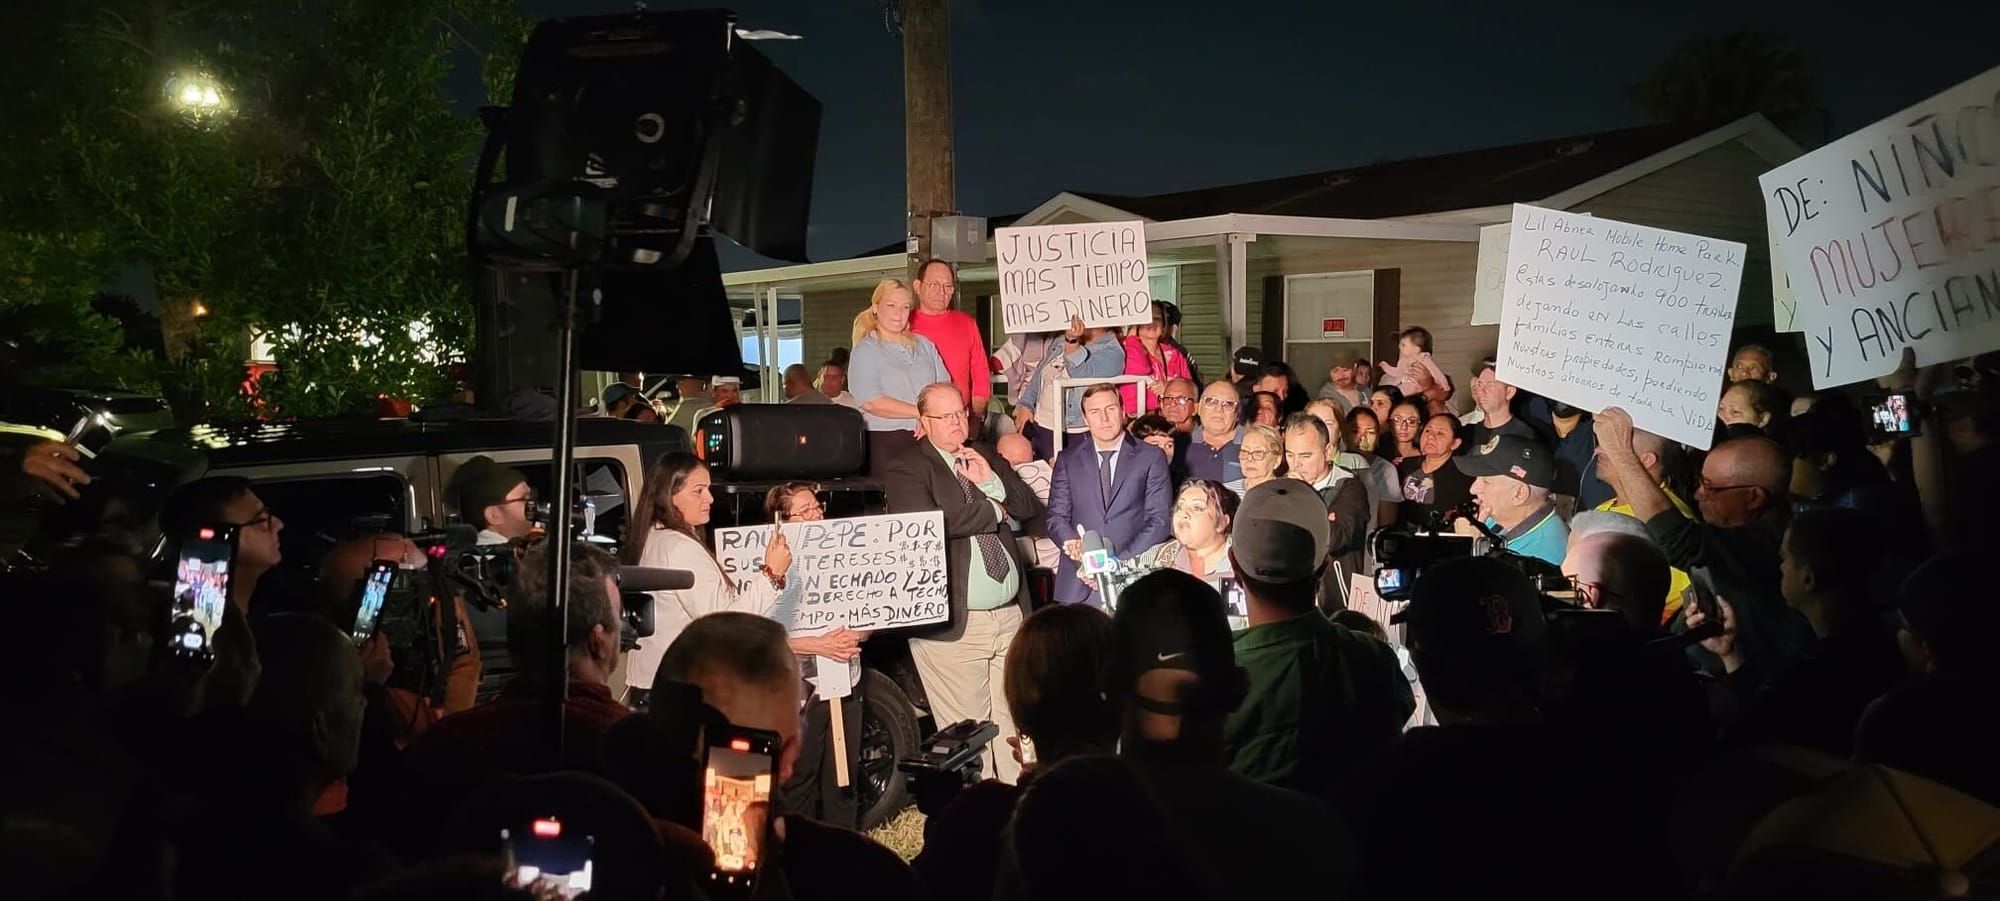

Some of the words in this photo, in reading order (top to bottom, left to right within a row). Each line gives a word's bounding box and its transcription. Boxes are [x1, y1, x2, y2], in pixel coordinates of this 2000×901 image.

[1773, 178, 1828, 237] DE:
[1002, 228, 1136, 265] JUSTICIA
[1537, 238, 1596, 264] RAUL
[1605, 229, 1644, 249] Mobile
[1654, 236, 1688, 255] Home
[1004, 267, 1057, 297] MAS
[1062, 258, 1145, 291] TIEMPO
[1005, 301, 1051, 328] MAS
[1059, 290, 1150, 323] DINERO
[1655, 288, 1689, 308] 900
[1516, 293, 1580, 321] dejando
[1658, 321, 1722, 347] calles
[1816, 326, 1833, 378] Y
[1609, 384, 1622, 399] de
[885, 520, 938, 543] POR
[796, 550, 897, 571] TERESES
[830, 569, 898, 589] ECHADO
[902, 570, 914, 592] Y
[806, 589, 884, 605] DERECHO
[889, 586, 898, 600] A
[882, 601, 946, 622] DINERO
